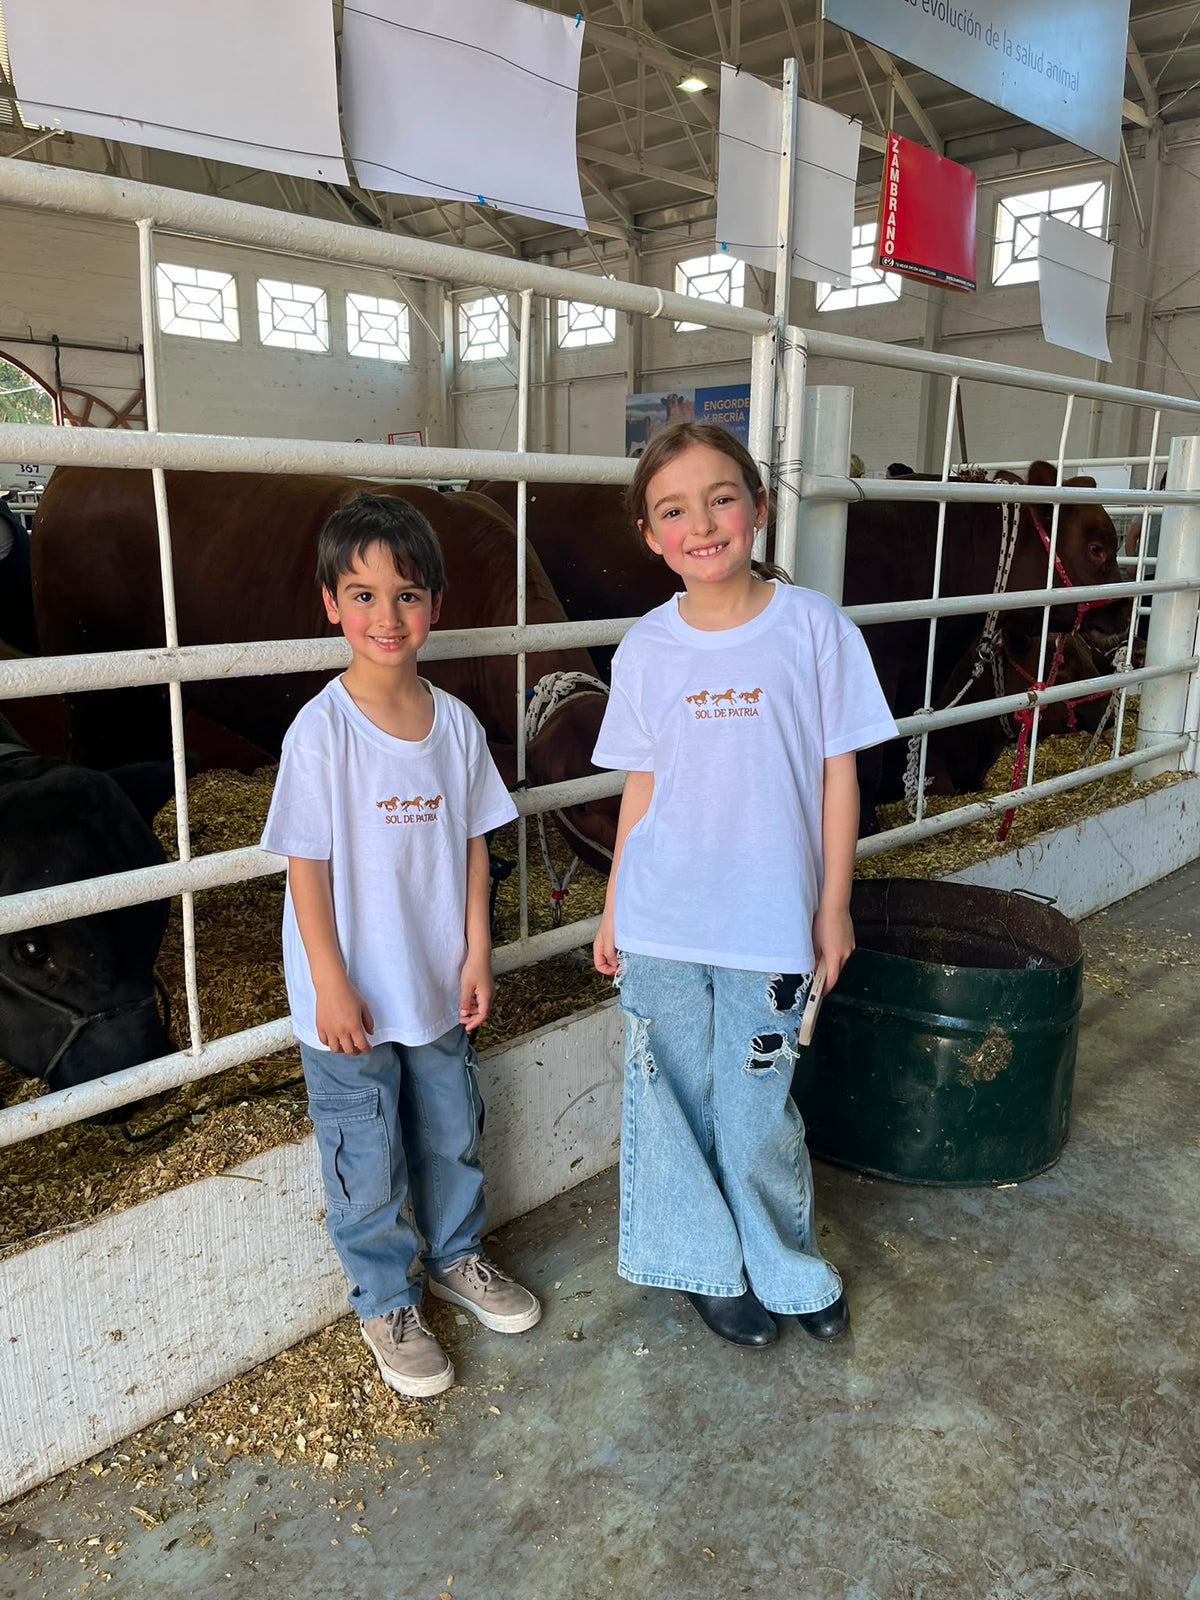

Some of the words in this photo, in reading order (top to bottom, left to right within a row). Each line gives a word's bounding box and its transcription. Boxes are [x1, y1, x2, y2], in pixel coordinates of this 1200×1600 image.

[922, 0, 982, 41] evolución
[985, 23, 1000, 50] de
[1003, 30, 1013, 57] la
[1016, 44, 1044, 74] salud
[1046, 61, 1081, 93] animal
[884, 138, 900, 255] ZAMBRANO
[704, 397, 751, 411] ENGORDE
[712, 410, 745, 423] RECRÍA
[695, 710, 712, 719] SOL
[714, 708, 727, 718] DE
[728, 707, 759, 717] PATRIA
[385, 815, 402, 824] SOL
[404, 814, 415, 823] DE
[416, 813, 438, 823] PATRIA
